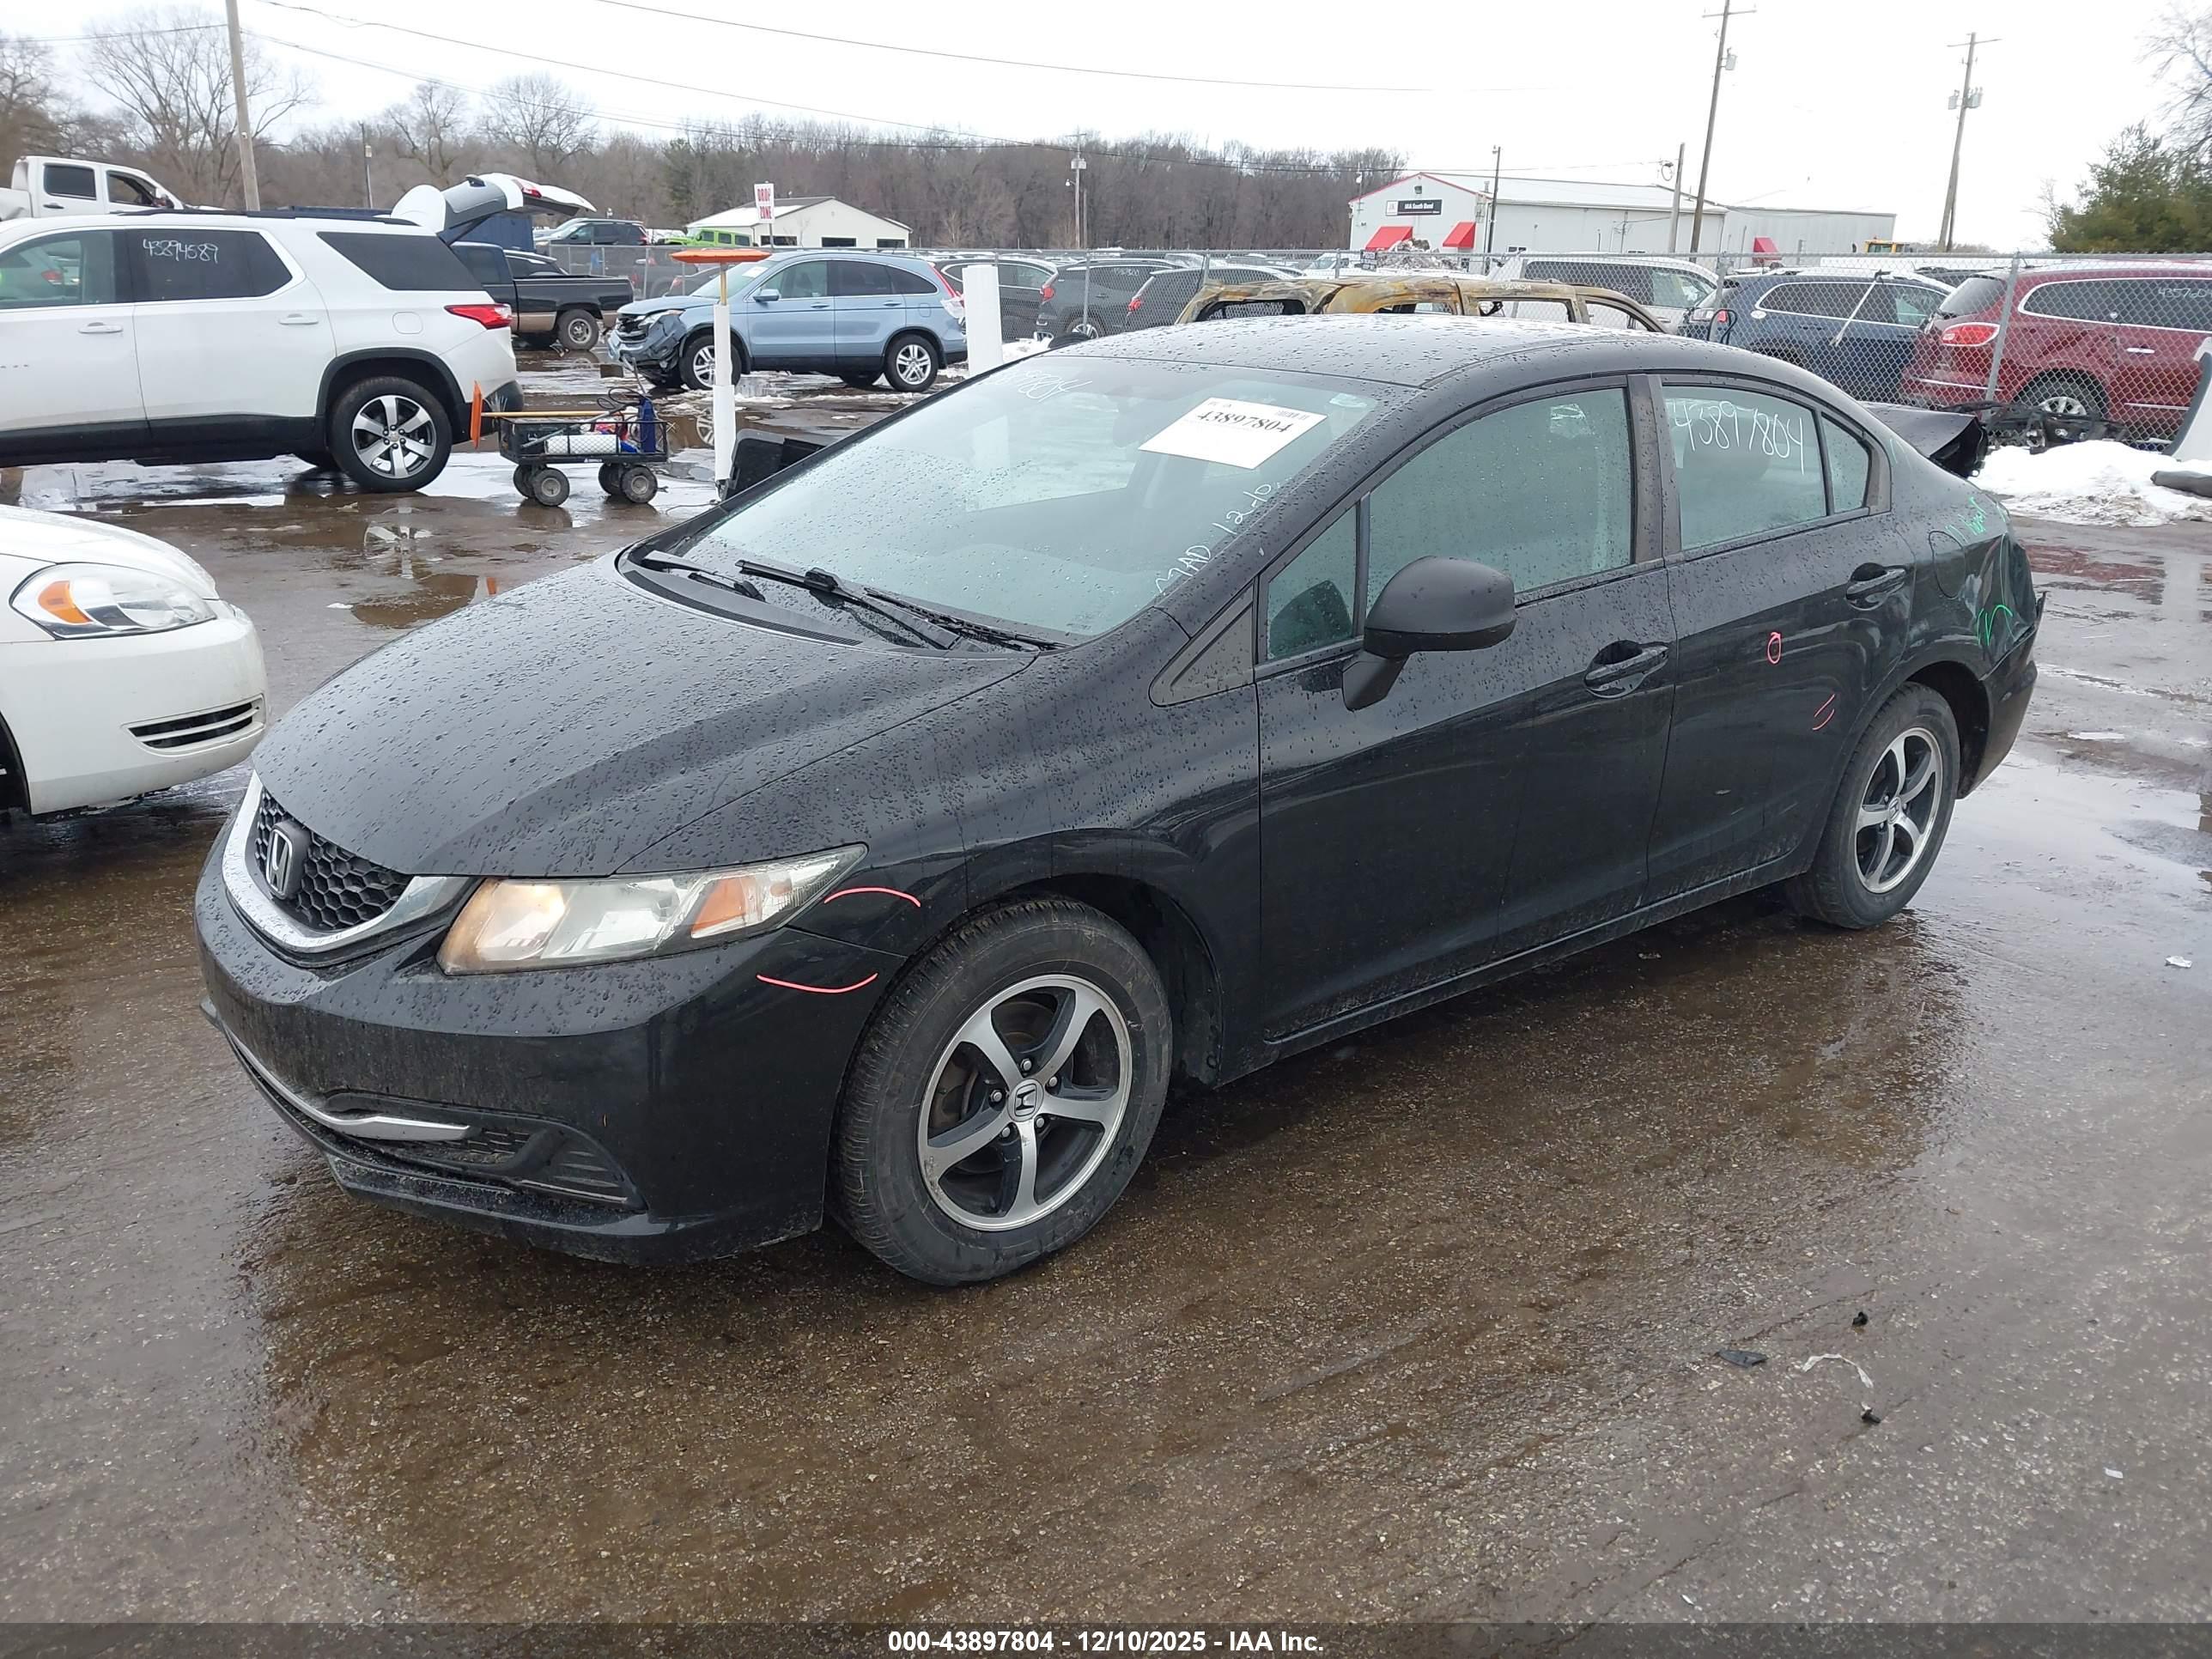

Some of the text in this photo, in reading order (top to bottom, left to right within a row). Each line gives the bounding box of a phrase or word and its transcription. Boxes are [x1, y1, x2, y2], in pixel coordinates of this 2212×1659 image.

[143, 238, 219, 264] 43894589
[1197, 410, 1294, 433] 43897804
[1674, 400, 1804, 475] 43897804
